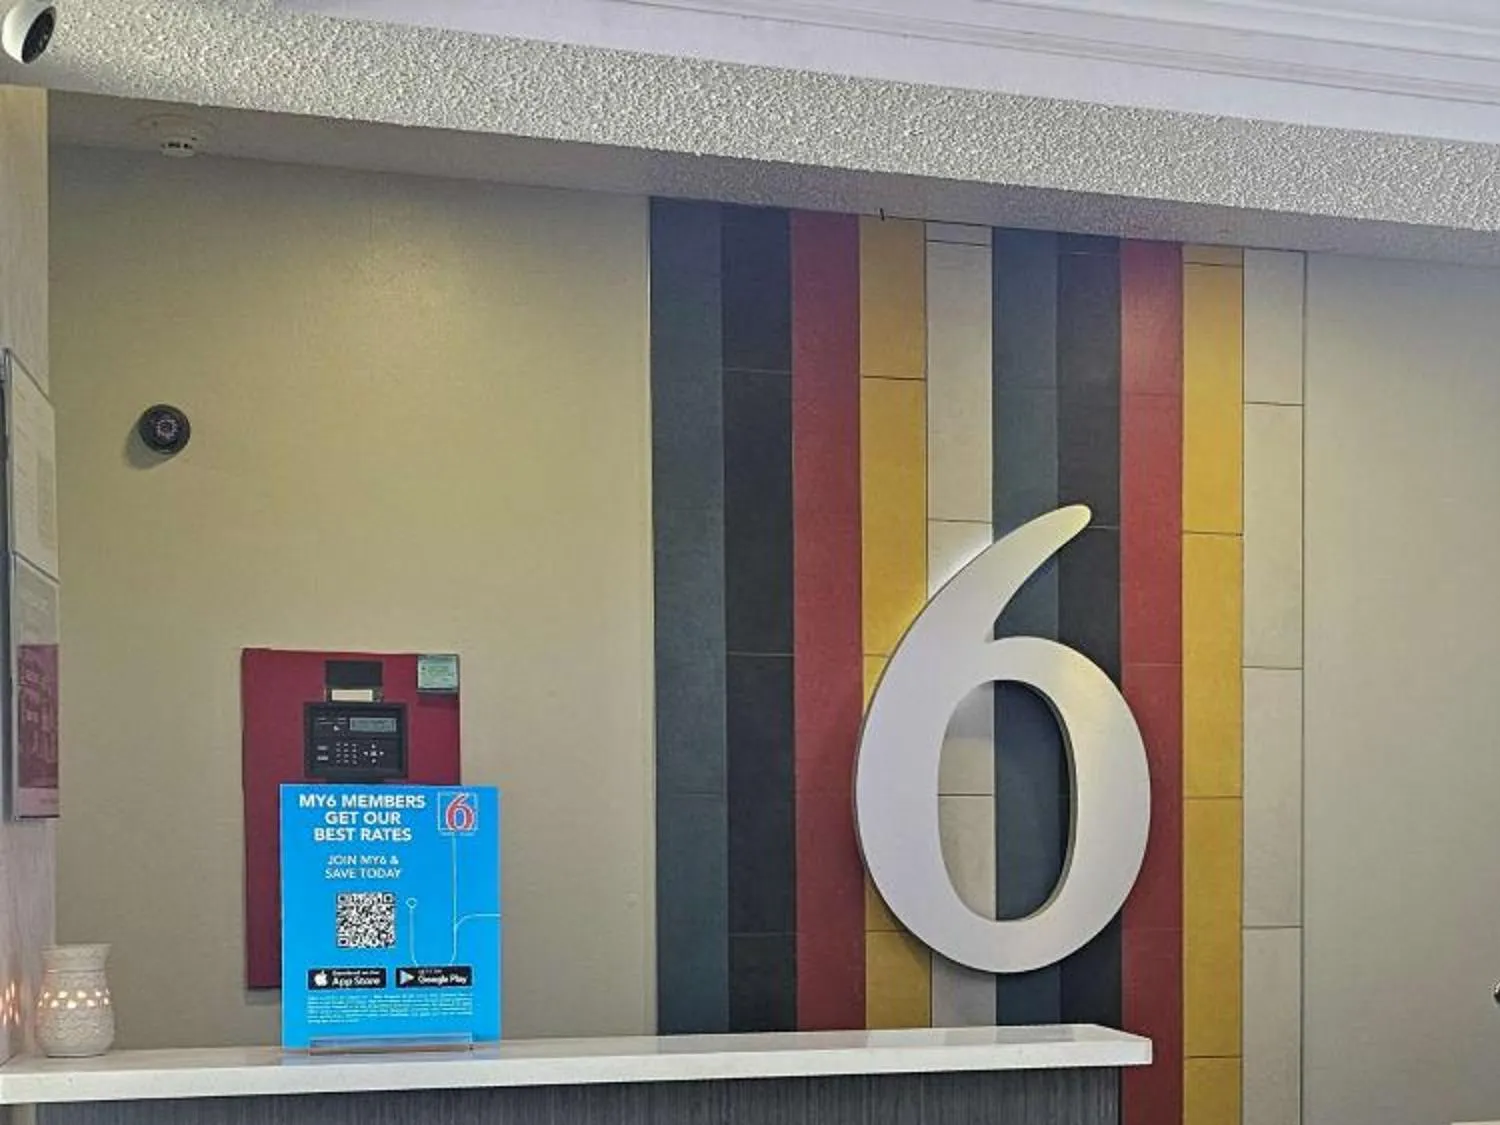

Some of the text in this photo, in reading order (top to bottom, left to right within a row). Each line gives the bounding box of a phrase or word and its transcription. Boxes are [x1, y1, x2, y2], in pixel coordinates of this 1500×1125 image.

[854, 503, 1152, 974] 6
[299, 794, 425, 809] MY6 MEMBERS
[325, 811, 401, 825] GET OUR
[445, 793, 475, 831] 6
[314, 827, 412, 842] BEST RATES
[327, 855, 399, 866] JOIN MY6 &
[325, 867, 401, 879] SAVE TODAY
[332, 976, 381, 988] App Store
[417, 974, 468, 987] Google Play
